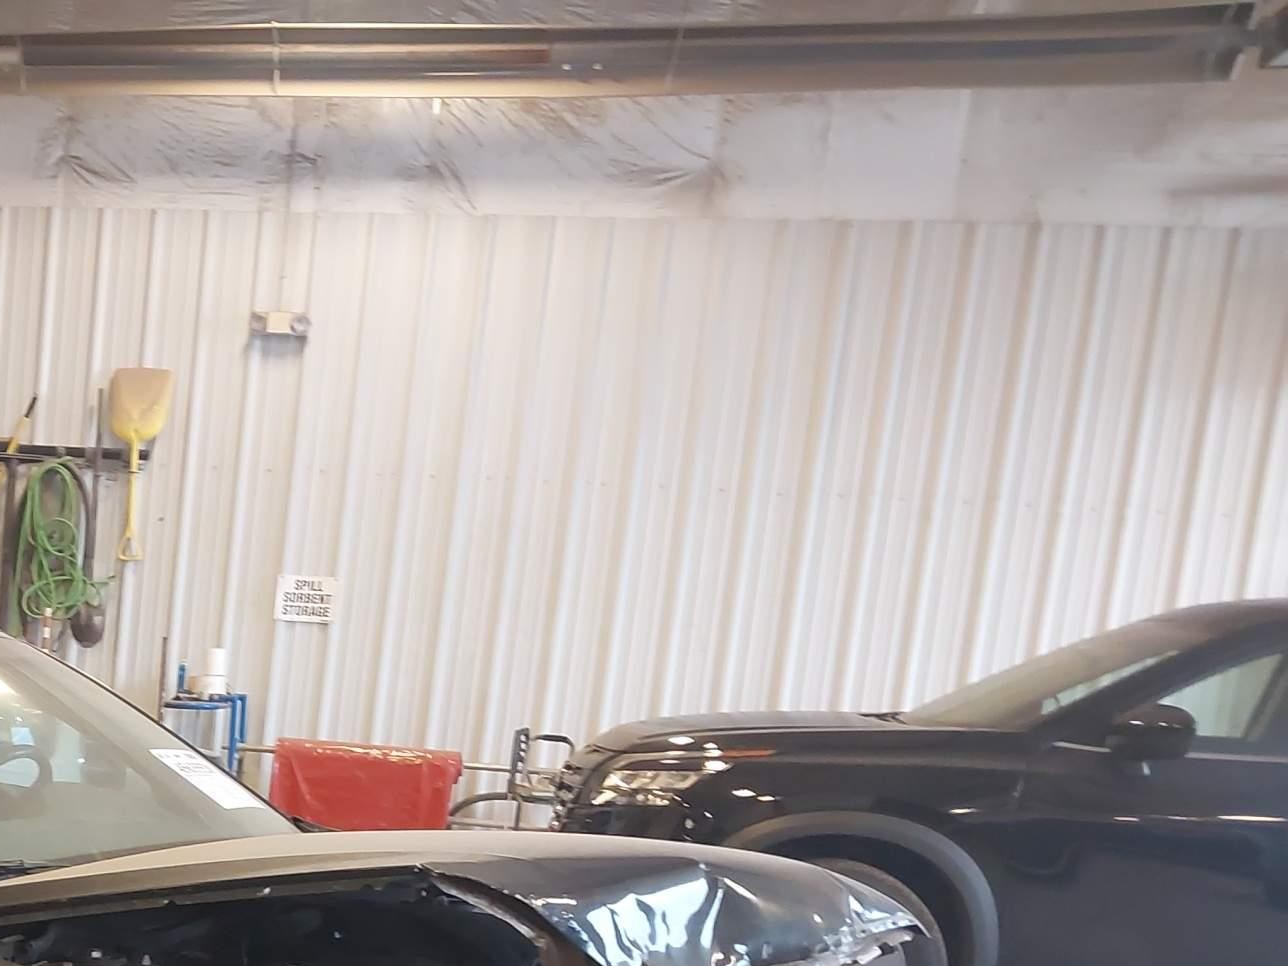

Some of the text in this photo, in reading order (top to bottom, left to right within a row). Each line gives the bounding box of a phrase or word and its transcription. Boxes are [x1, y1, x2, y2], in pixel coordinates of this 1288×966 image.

[294, 579, 324, 592] SPILL
[282, 591, 333, 605] SORBENT
[281, 604, 331, 618] STORAGE
